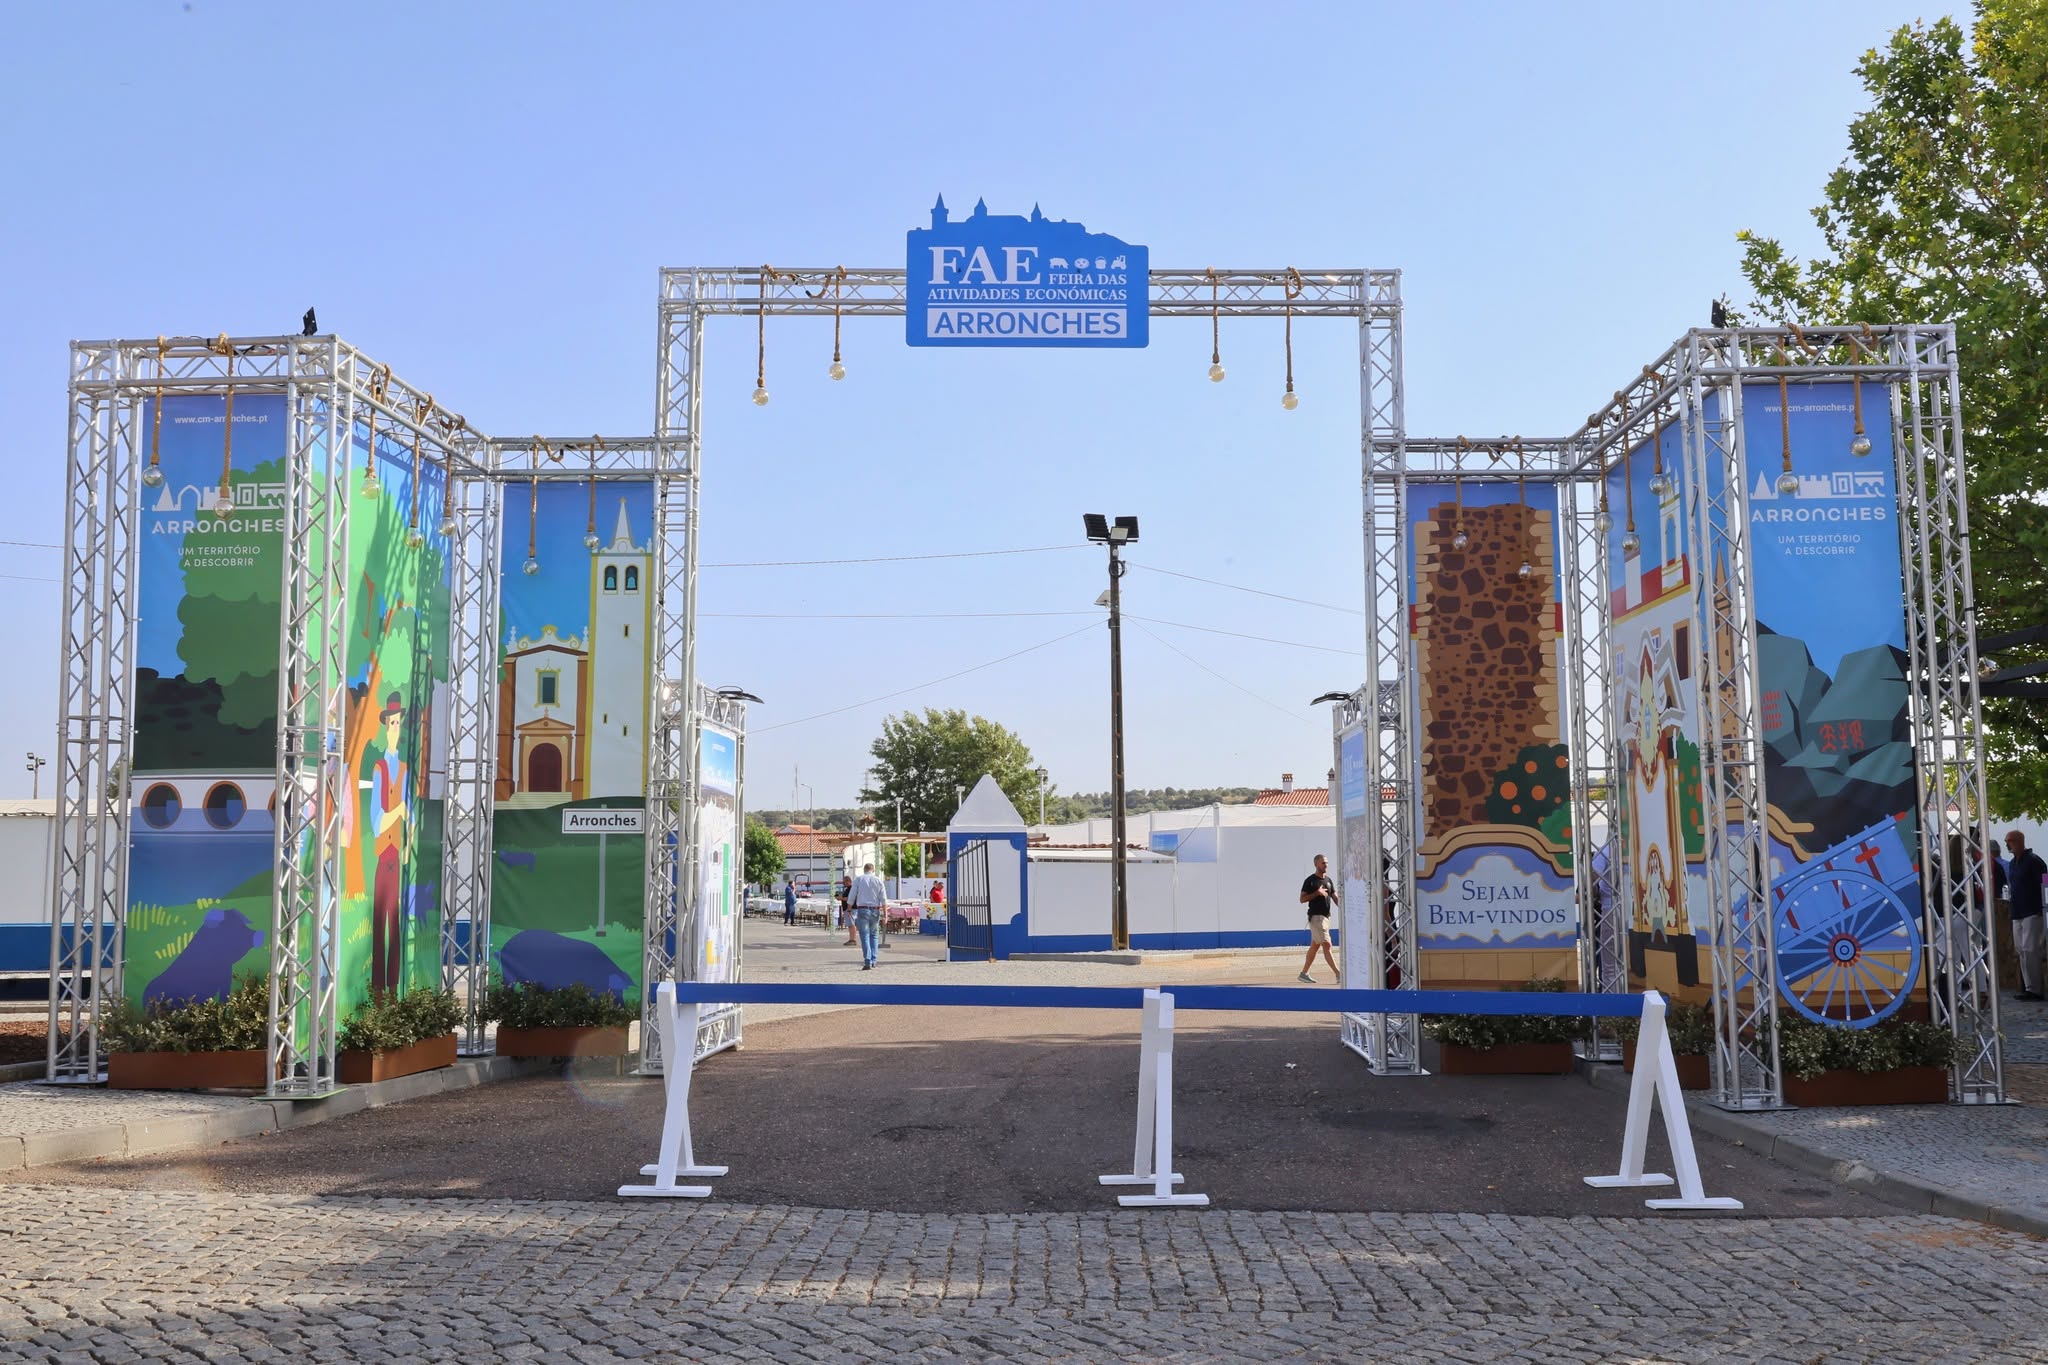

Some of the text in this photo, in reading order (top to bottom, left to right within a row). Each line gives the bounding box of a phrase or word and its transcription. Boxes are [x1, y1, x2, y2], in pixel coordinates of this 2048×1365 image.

[928, 246, 1040, 285] FAE
[1049, 274, 1127, 285] FEIRA DAS
[928, 286, 1127, 300] ATIVIDADES ECONÓMICAS
[934, 312, 1121, 335] ARRONCHES
[175, 415, 268, 424] www.cm-arrnches.pt
[1752, 508, 1886, 522] ARRONCHES
[152, 519, 284, 534] ARRONCHES
[1799, 535, 1861, 543] TERRITÓRIO
[178, 545, 260, 555] UM TERRITÓRIO
[1796, 547, 1855, 555] DESCOBRIR
[570, 815, 636, 826] Arronches
